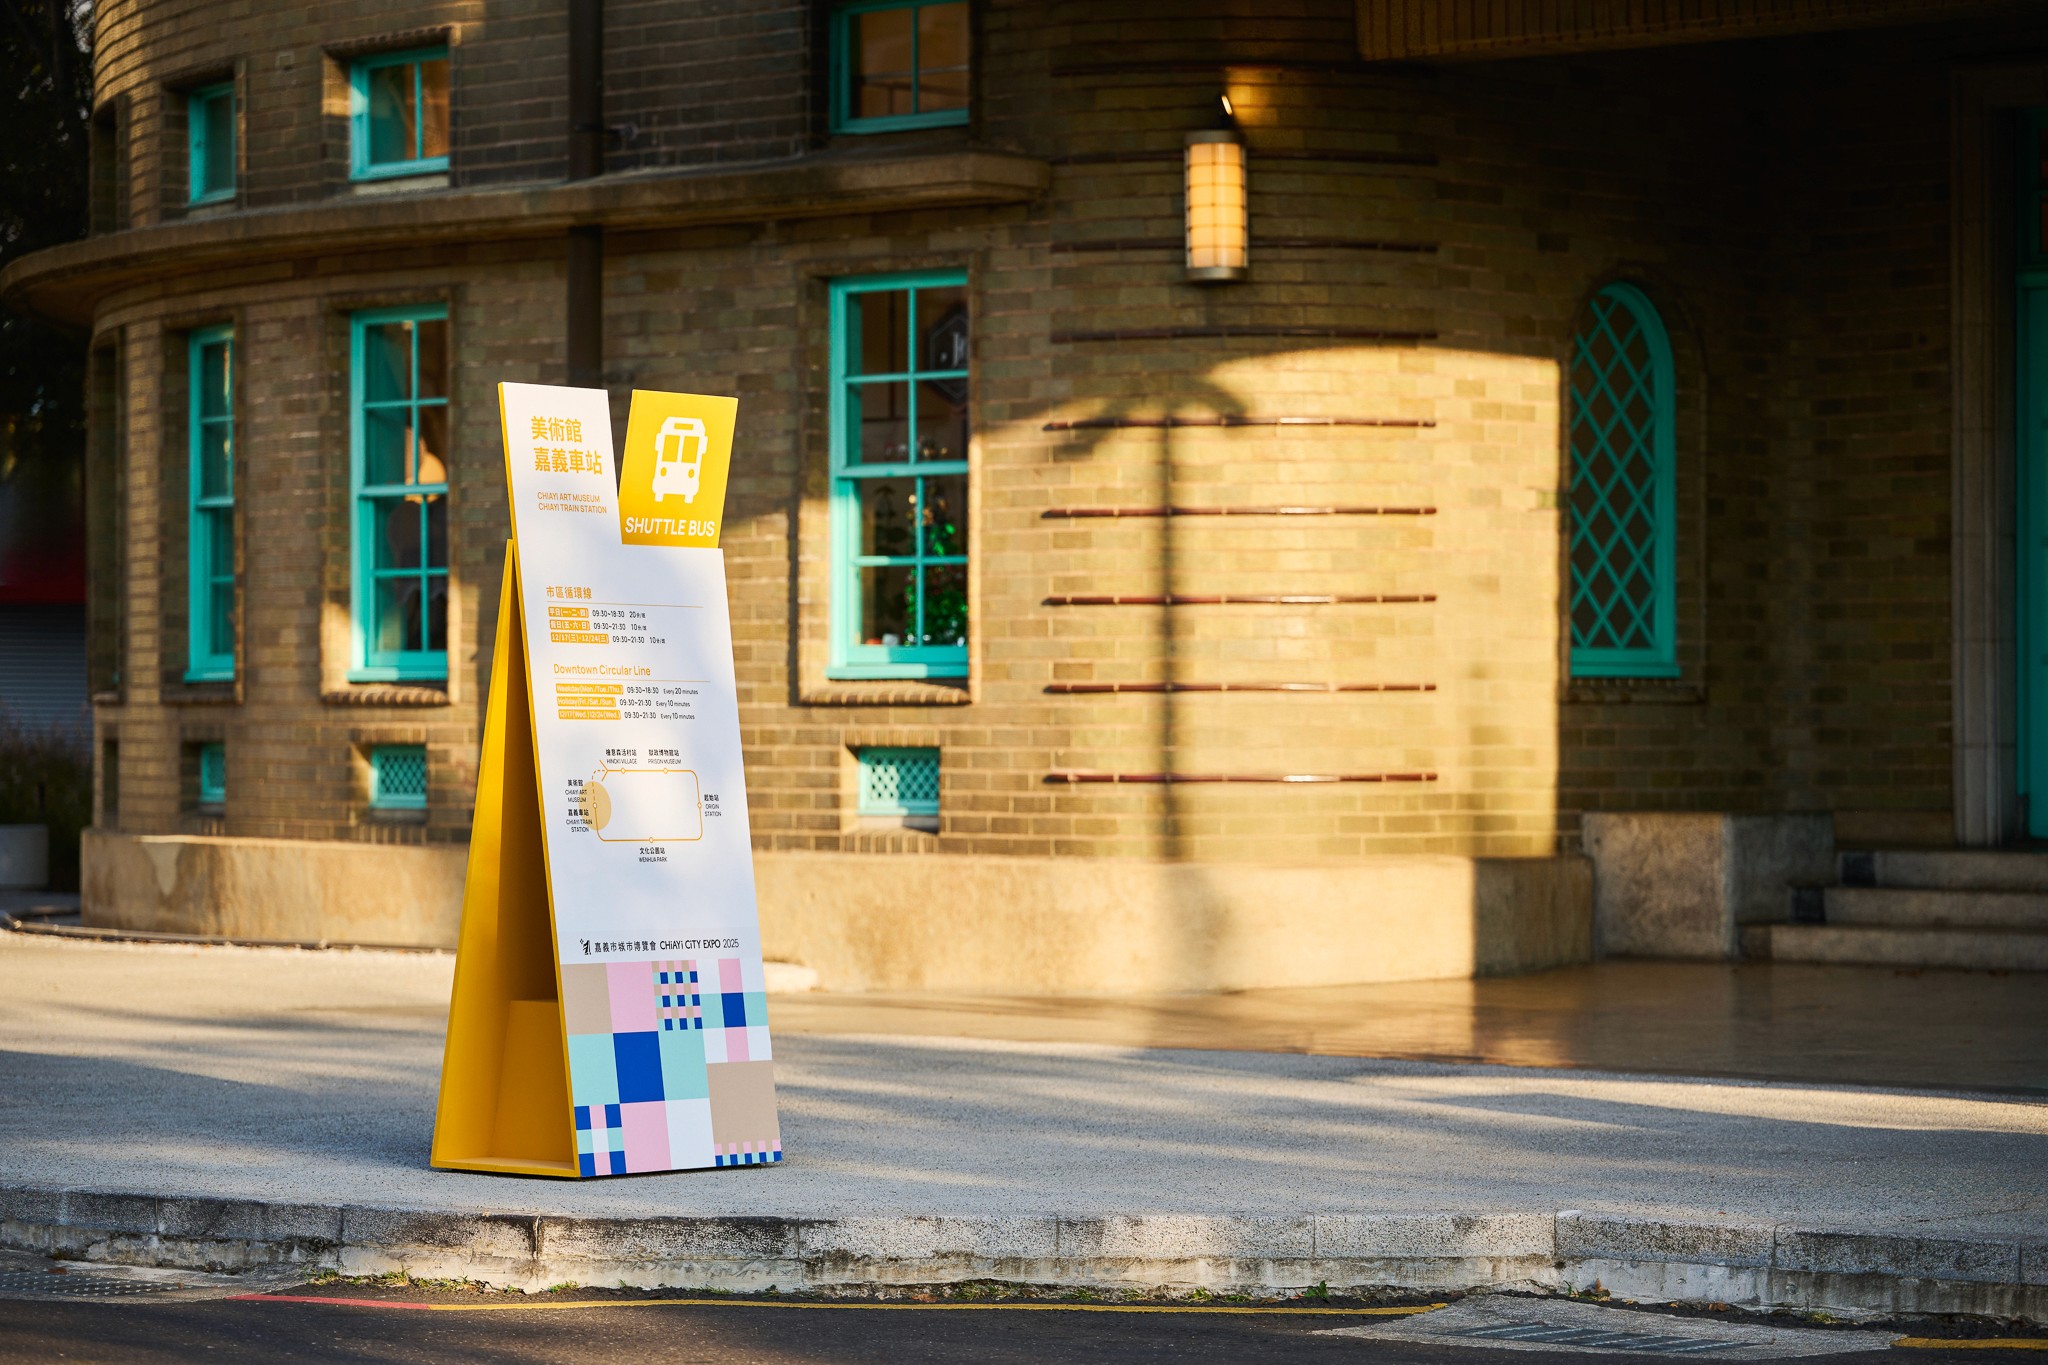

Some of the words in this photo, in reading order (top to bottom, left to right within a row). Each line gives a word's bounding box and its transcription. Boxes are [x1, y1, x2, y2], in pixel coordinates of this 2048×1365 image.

[531, 416, 583, 443] 美術館
[533, 447, 603, 475] 嘉義車站
[537, 491, 558, 500] CHIAYI
[559, 493, 571, 501] ART
[572, 494, 601, 503] MUSEUM
[538, 502, 560, 511] CHIAYI
[560, 504, 580, 512] TRAIN
[580, 505, 607, 514] STATION
[625, 516, 686, 535] SHUTTLE
[688, 519, 715, 537] BUS
[546, 585, 592, 599] 市區循環線
[553, 663, 598, 674] Downtown
[600, 664, 632, 676] Circular
[633, 666, 651, 676] Line
[674, 687, 682, 695] 20
[672, 712, 679, 720] 10
[594, 940, 657, 953] 嘉義市城市博覽會
[702, 939, 721, 949] EXPO
[722, 938, 740, 949] 2025
